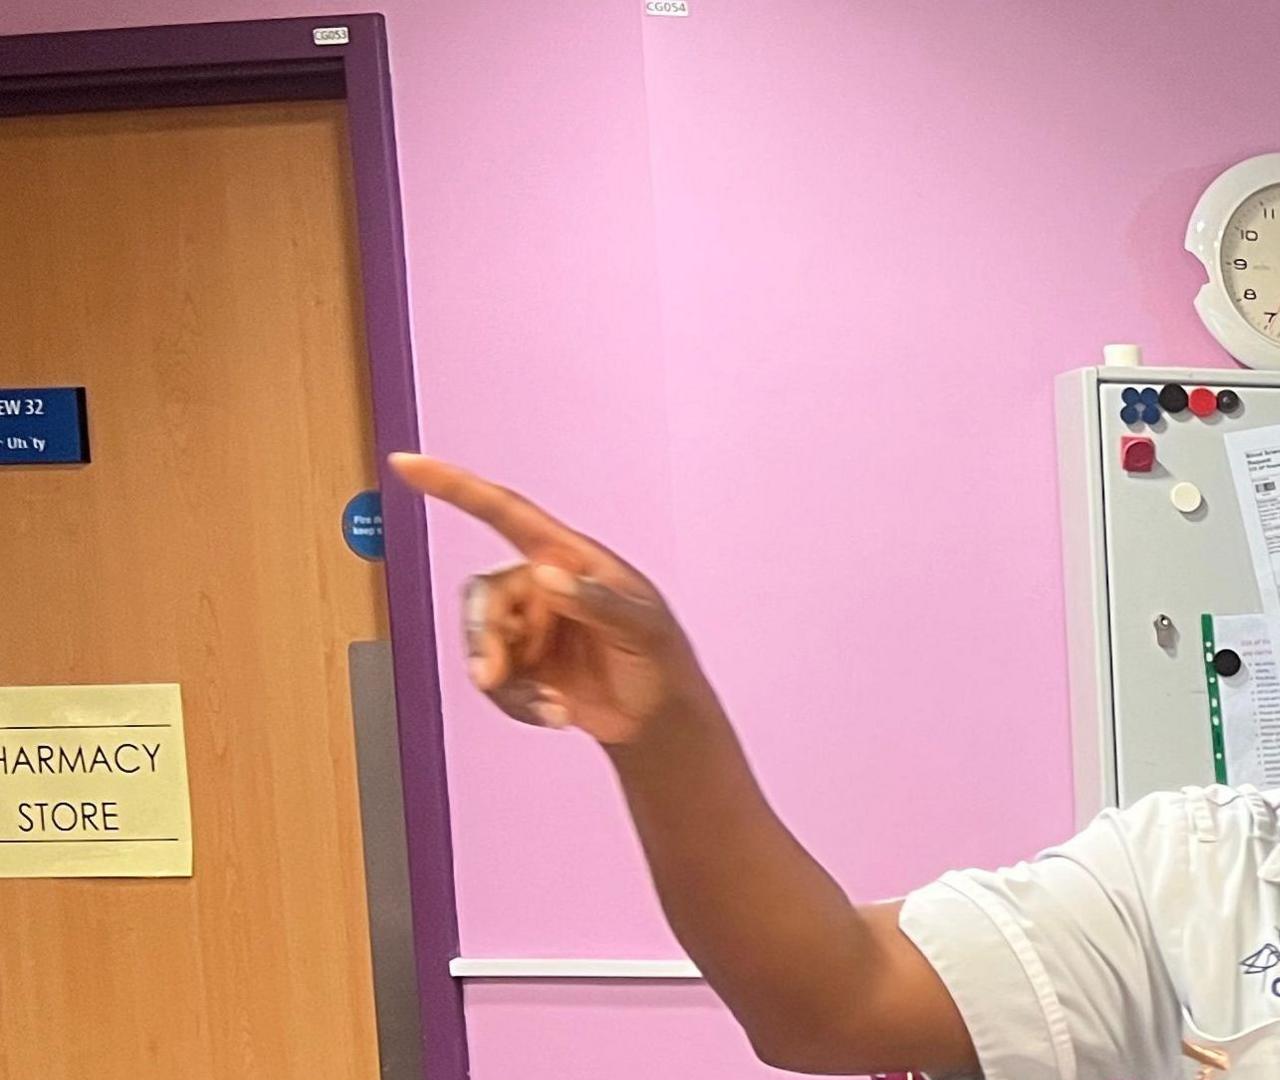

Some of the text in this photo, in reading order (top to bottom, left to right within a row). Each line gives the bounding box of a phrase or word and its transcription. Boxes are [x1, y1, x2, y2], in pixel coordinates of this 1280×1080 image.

[1263, 208, 1275, 219] 11
[1240, 230, 1258, 241] 10
[1233, 259, 1248, 271] 9
[1243, 289, 1257, 301] 8
[1264, 312, 1277, 324] 7
[25, 398, 45, 415] 32
[17, 801, 119, 832] STORE
